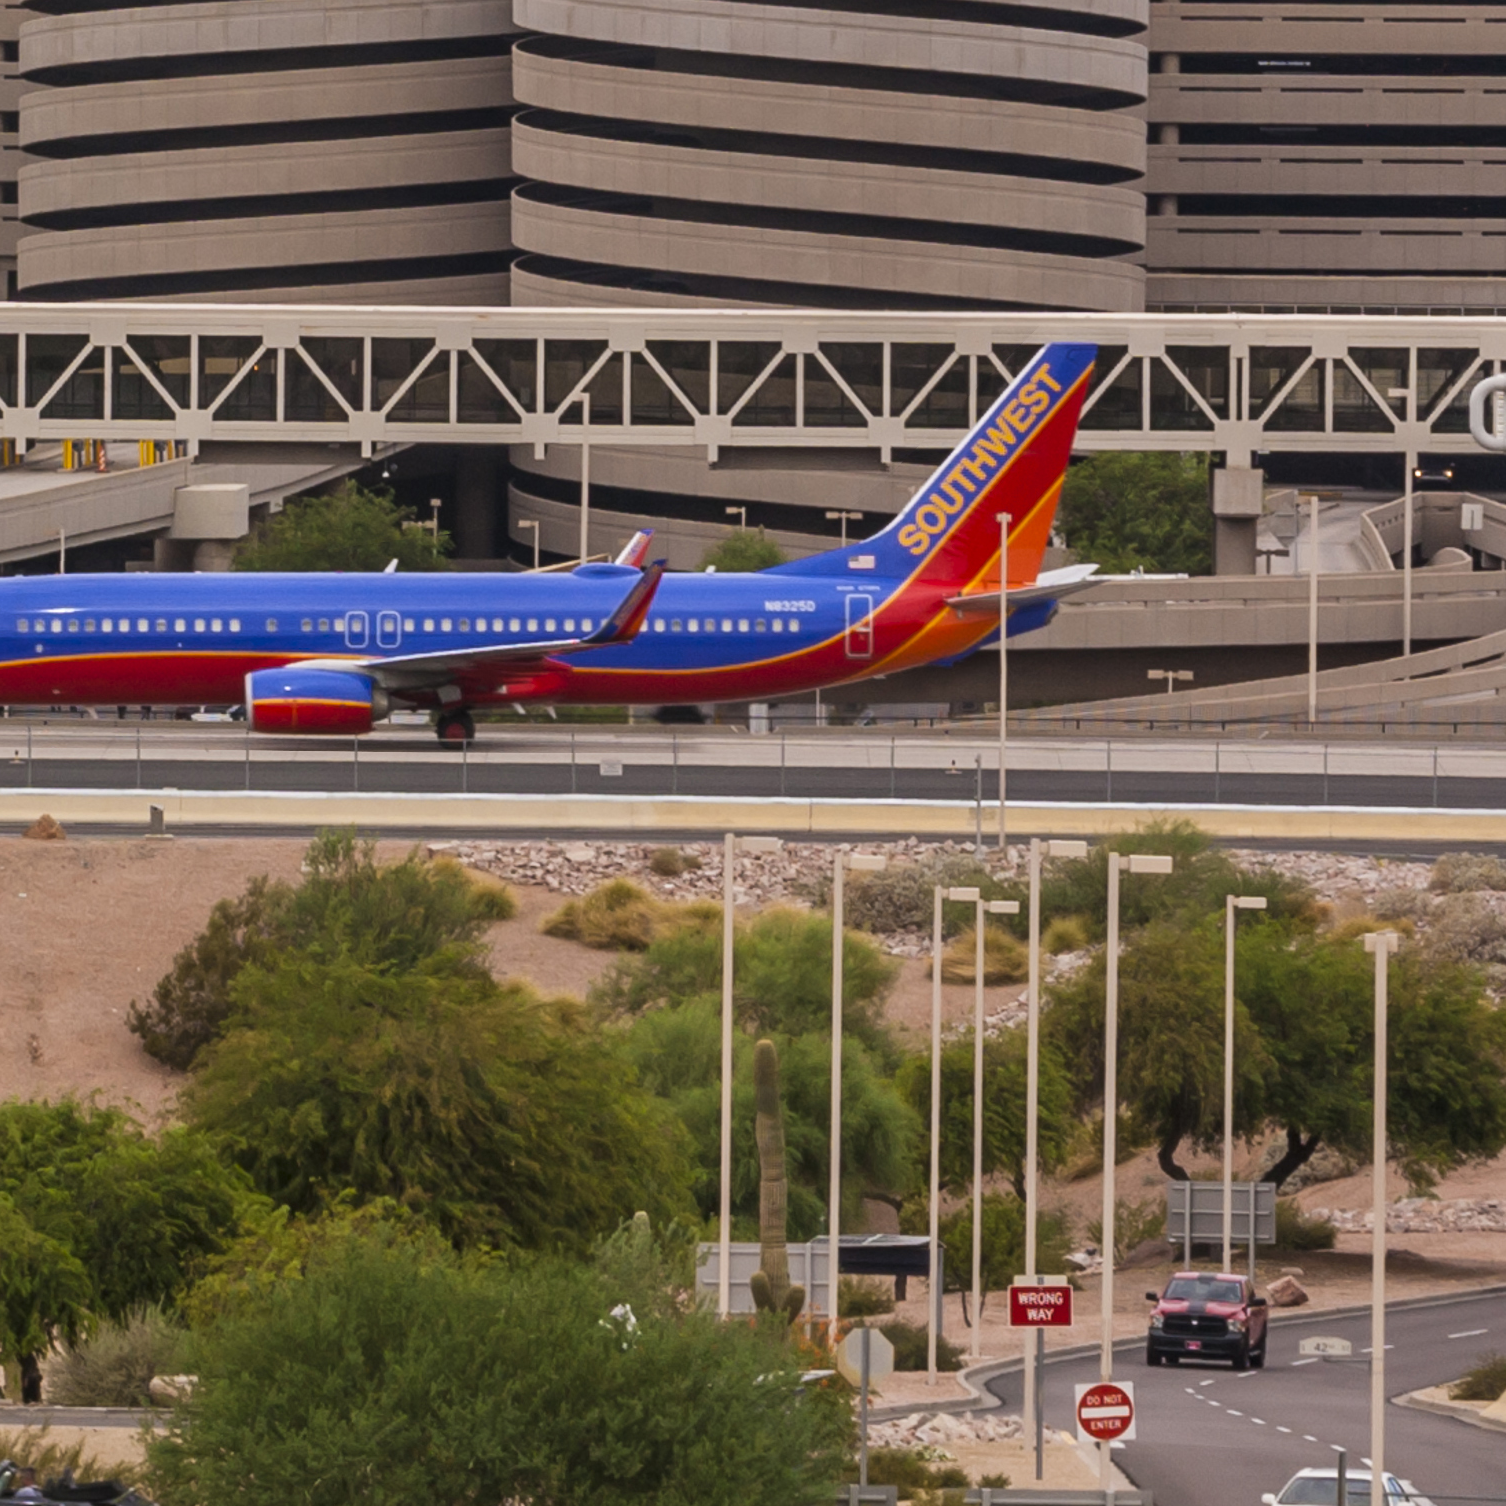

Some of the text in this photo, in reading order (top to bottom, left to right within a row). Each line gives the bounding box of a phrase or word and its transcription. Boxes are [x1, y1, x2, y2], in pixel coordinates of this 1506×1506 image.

[897, 362, 1062, 556] SOUTHWEST
[1017, 1291, 1064, 1305] WRONG
[1026, 1307, 1055, 1321] WAY
[1086, 1393, 1123, 1405] DO NOT
[1090, 1419, 1122, 1430] ENTER
